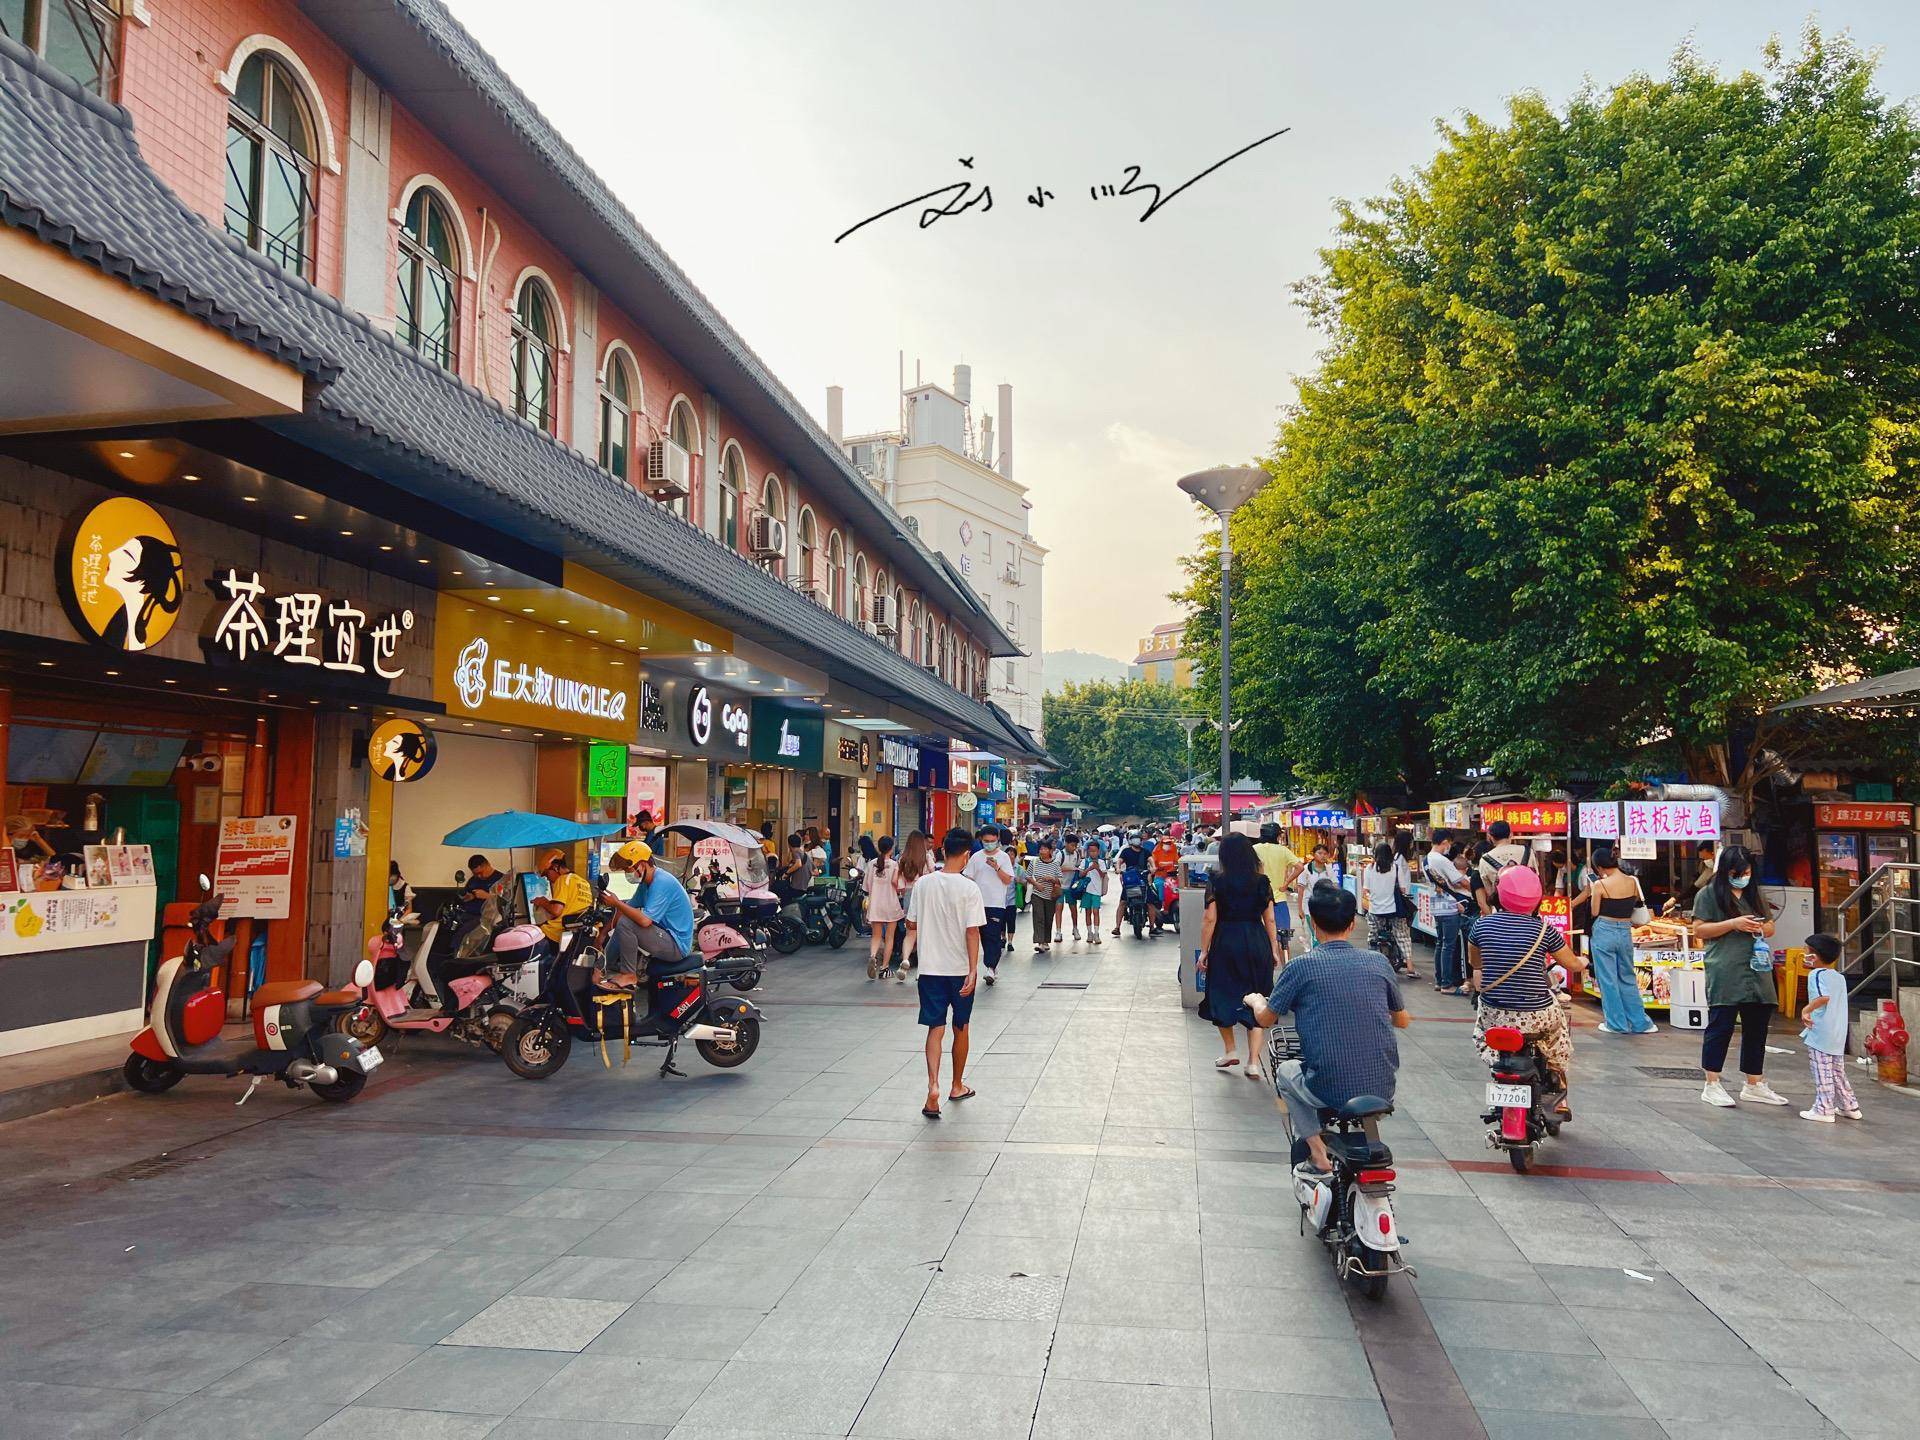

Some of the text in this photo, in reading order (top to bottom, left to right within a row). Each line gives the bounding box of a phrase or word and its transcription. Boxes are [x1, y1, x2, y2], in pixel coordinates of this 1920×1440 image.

[215, 568, 405, 679] 茶理宜世
[489, 659, 553, 706] 丘大叔
[1629, 804, 1717, 836] 铁板鱿鱼
[1491, 1093, 1526, 1104] 177206
